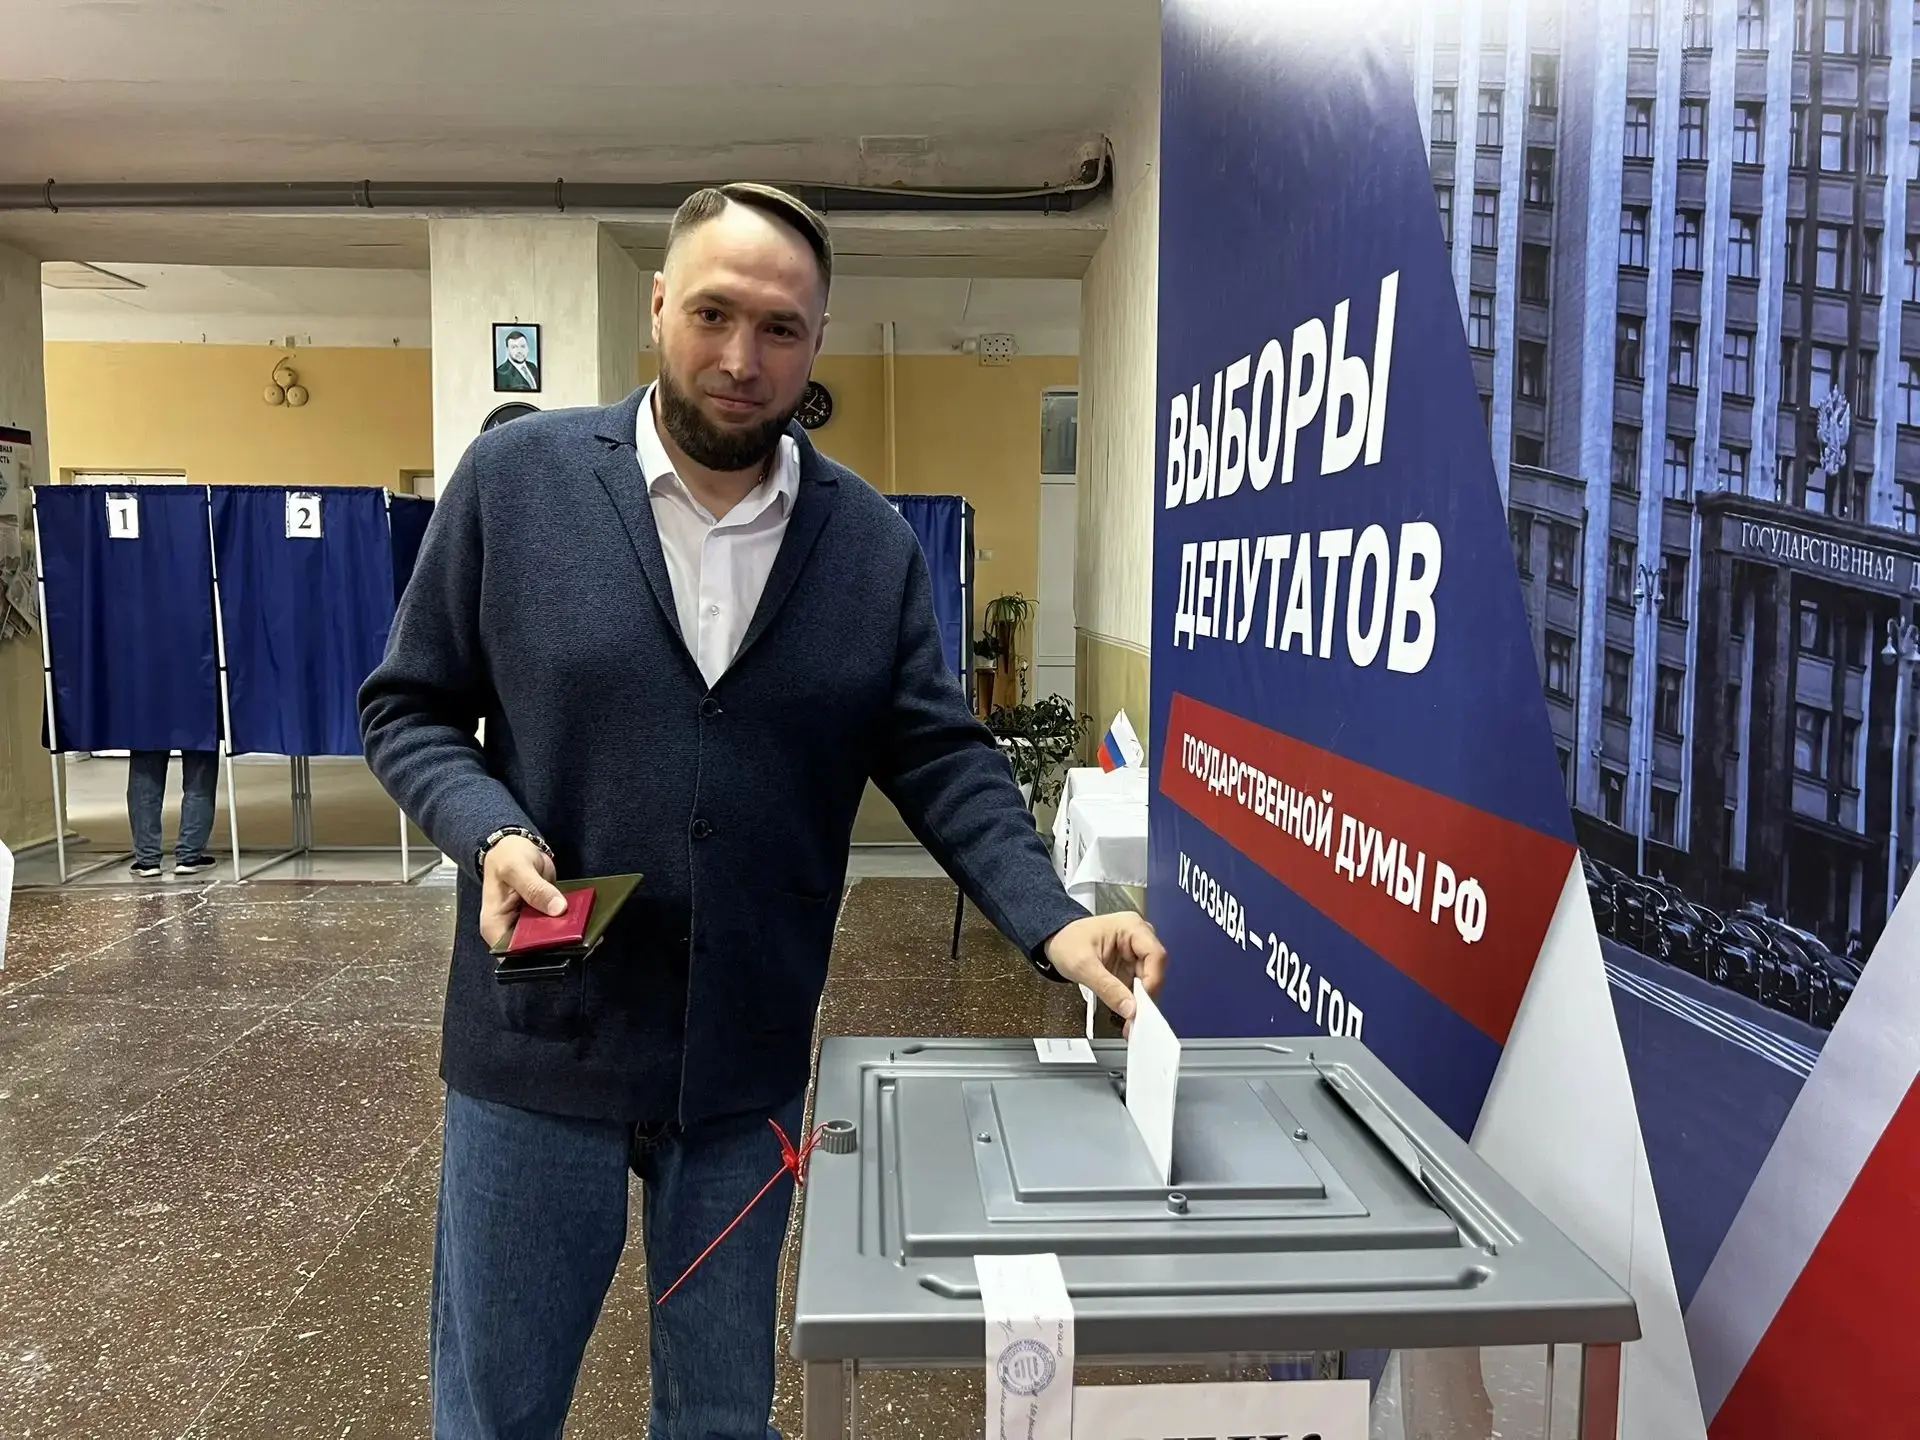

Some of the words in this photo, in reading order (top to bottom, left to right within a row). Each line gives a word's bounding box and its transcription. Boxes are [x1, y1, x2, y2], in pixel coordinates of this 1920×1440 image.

[1165, 269, 1400, 510] ВЫБОРЫ
[119, 508, 129, 530] 1
[297, 507, 312, 529] 2
[1741, 522, 1895, 582] ГОСУДАРСТВЕННАЯ
[1174, 521, 1443, 674] ДЕПУТАТОВ
[1182, 732, 1334, 858] ГОСУДАРСТВЕННОЙ
[1334, 813, 1426, 914] ДУМЫ
[1430, 860, 1487, 945] РФ
[1178, 851, 1191, 894] IX
[1192, 864, 1247, 951] СОЗЫВА
[1265, 932, 1312, 1013] 2026
